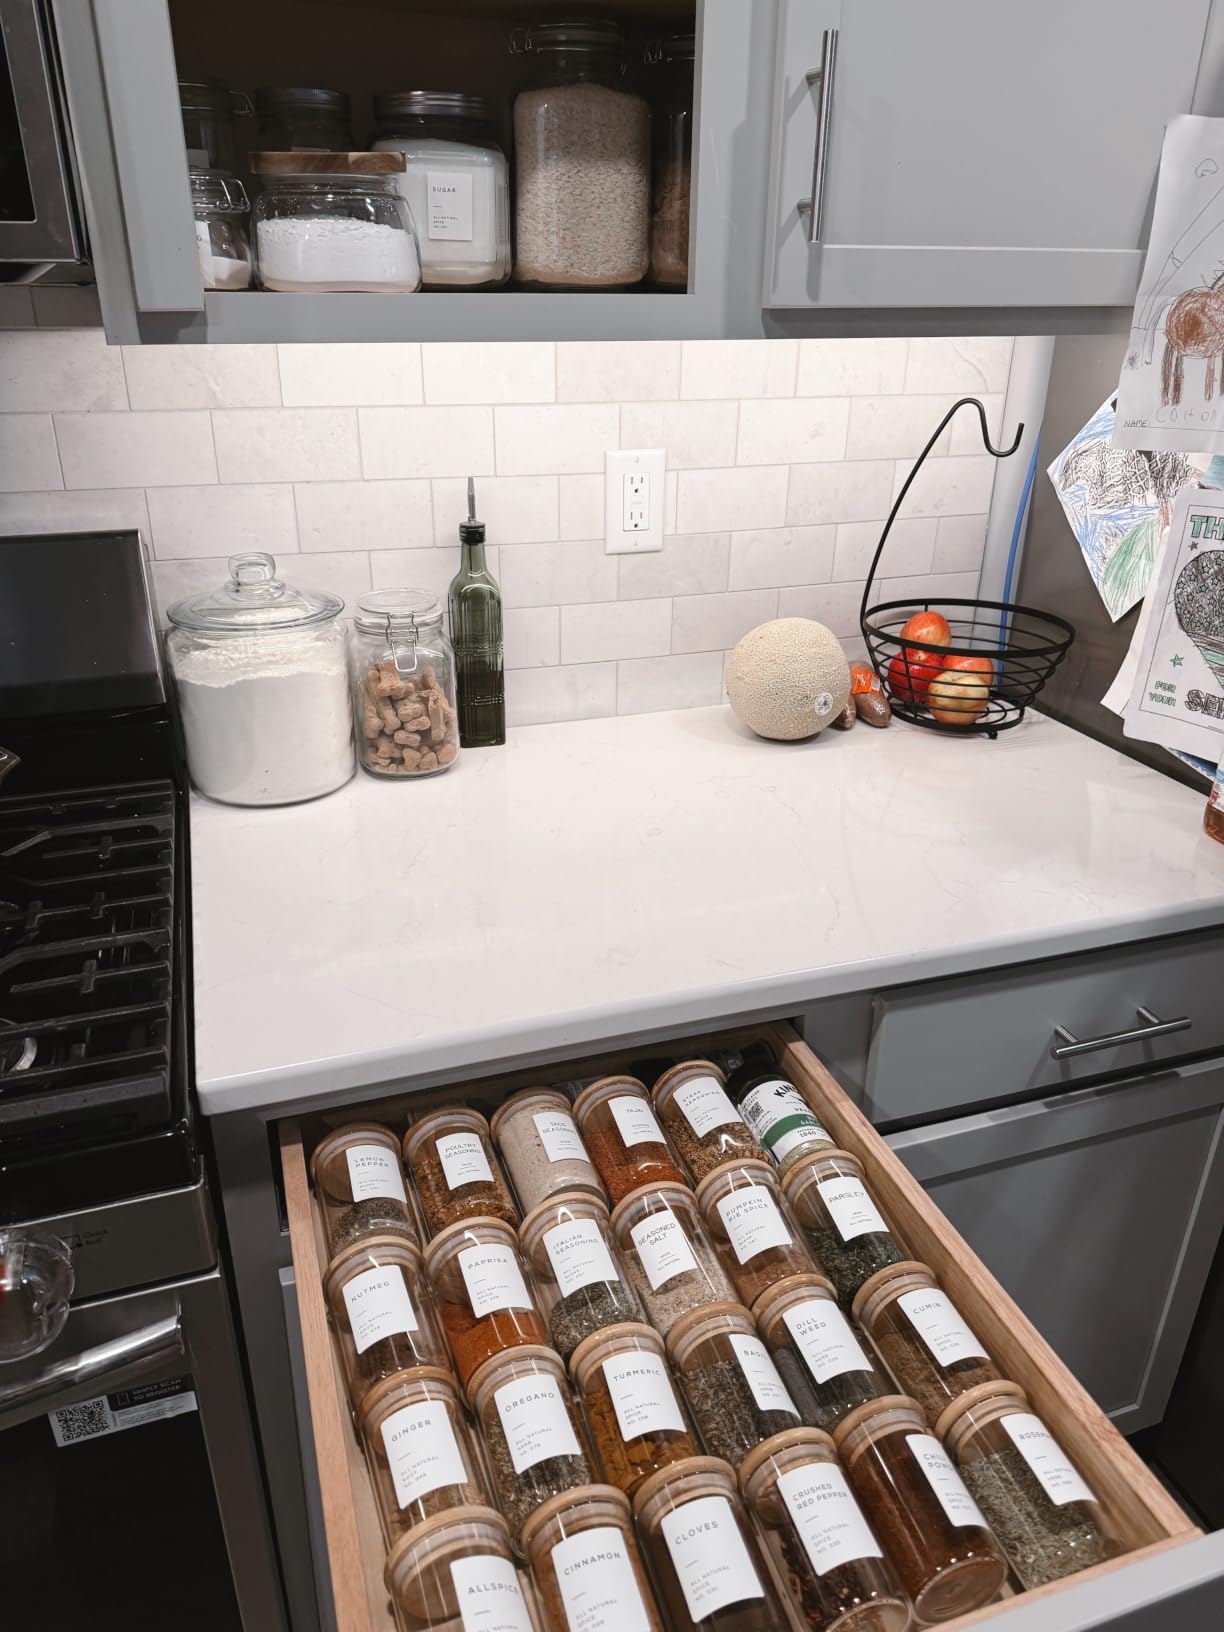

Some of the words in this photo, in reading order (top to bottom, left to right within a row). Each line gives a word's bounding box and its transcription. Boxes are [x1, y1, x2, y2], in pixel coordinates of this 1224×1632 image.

[1154, 680, 1177, 693] FOR
[1148, 692, 1177, 707] YOUR
[682, 1090, 702, 1102] STEAK
[445, 1143, 476, 1152] POULTRY
[828, 1192, 865, 1203] PARSLEY
[726, 1198, 763, 1217] PUMPKIN
[728, 1213, 741, 1223] PIE
[743, 1203, 768, 1214] SPICE
[553, 1234, 583, 1250] ITALIAN
[637, 1222, 676, 1247] SEASONED
[649, 1233, 668, 1246] SALT
[555, 1239, 599, 1256] SEASONING
[468, 1257, 508, 1270] PAPRIKA
[351, 1281, 391, 1303] NUTMEG
[913, 1302, 942, 1314] CUMIN
[796, 1317, 818, 1330] DILL
[799, 1321, 827, 1337] WEED
[613, 1368, 661, 1382] TURMERIC
[505, 1392, 555, 1413] OREGANO
[391, 1418, 432, 1442] GINGER
[792, 1482, 833, 1502] CRUSHED
[796, 1497, 814, 1511] RED
[815, 1491, 848, 1504] PEPPER
[674, 1520, 720, 1546] CLOVES
[564, 1552, 621, 1576] CINNAMON
[467, 1581, 520, 1596] ALLSPICE
